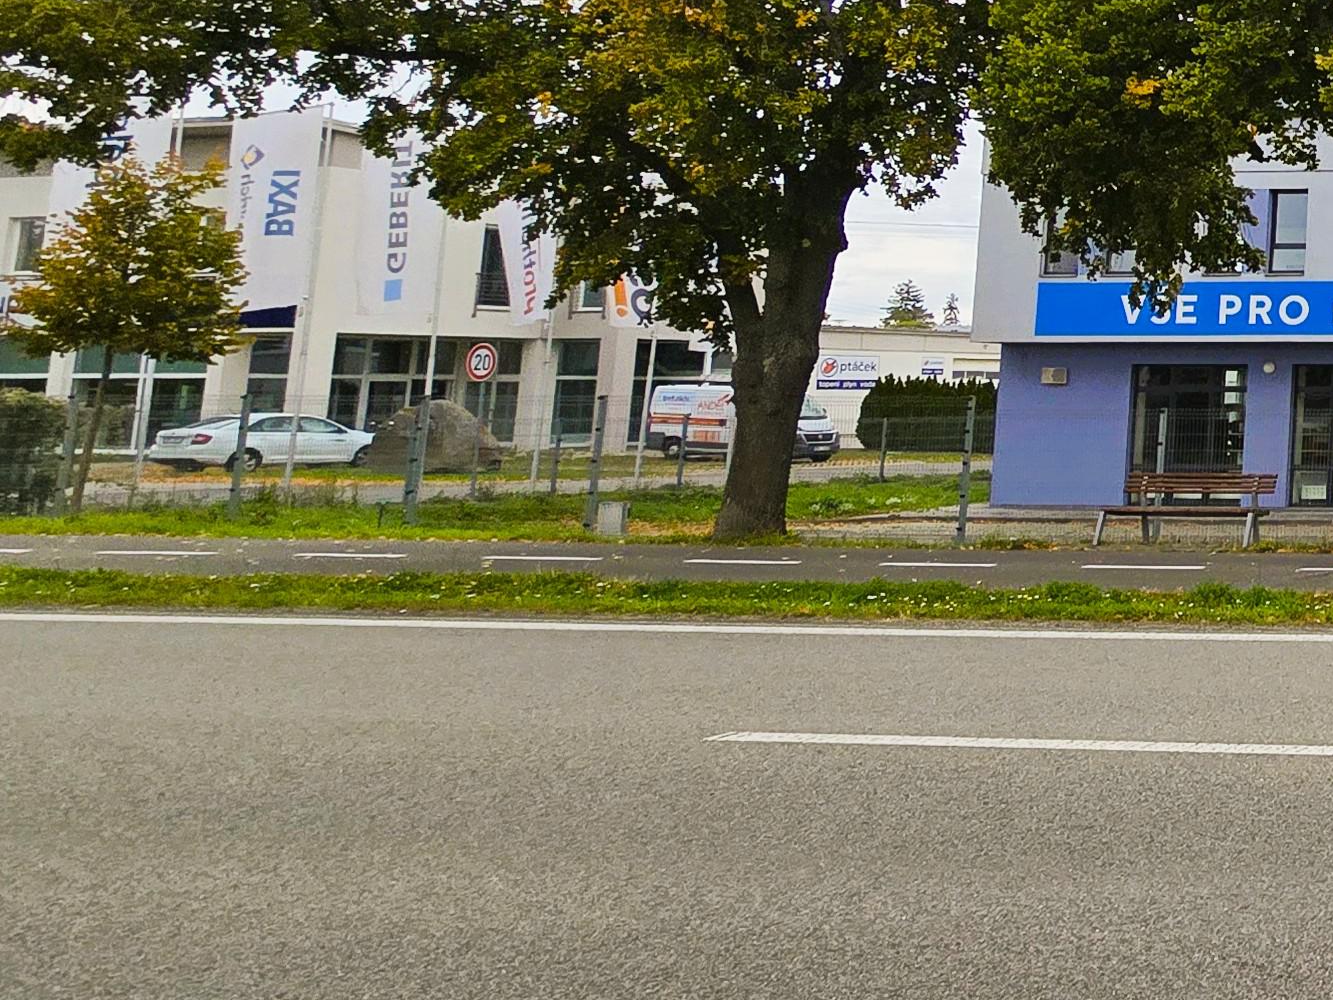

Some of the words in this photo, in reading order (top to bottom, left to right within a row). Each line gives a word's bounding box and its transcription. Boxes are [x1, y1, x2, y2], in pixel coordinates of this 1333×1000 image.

[1218, 294, 1310, 326] PRO
[474, 353, 491, 371] 20
[840, 361, 877, 374] ptáček
